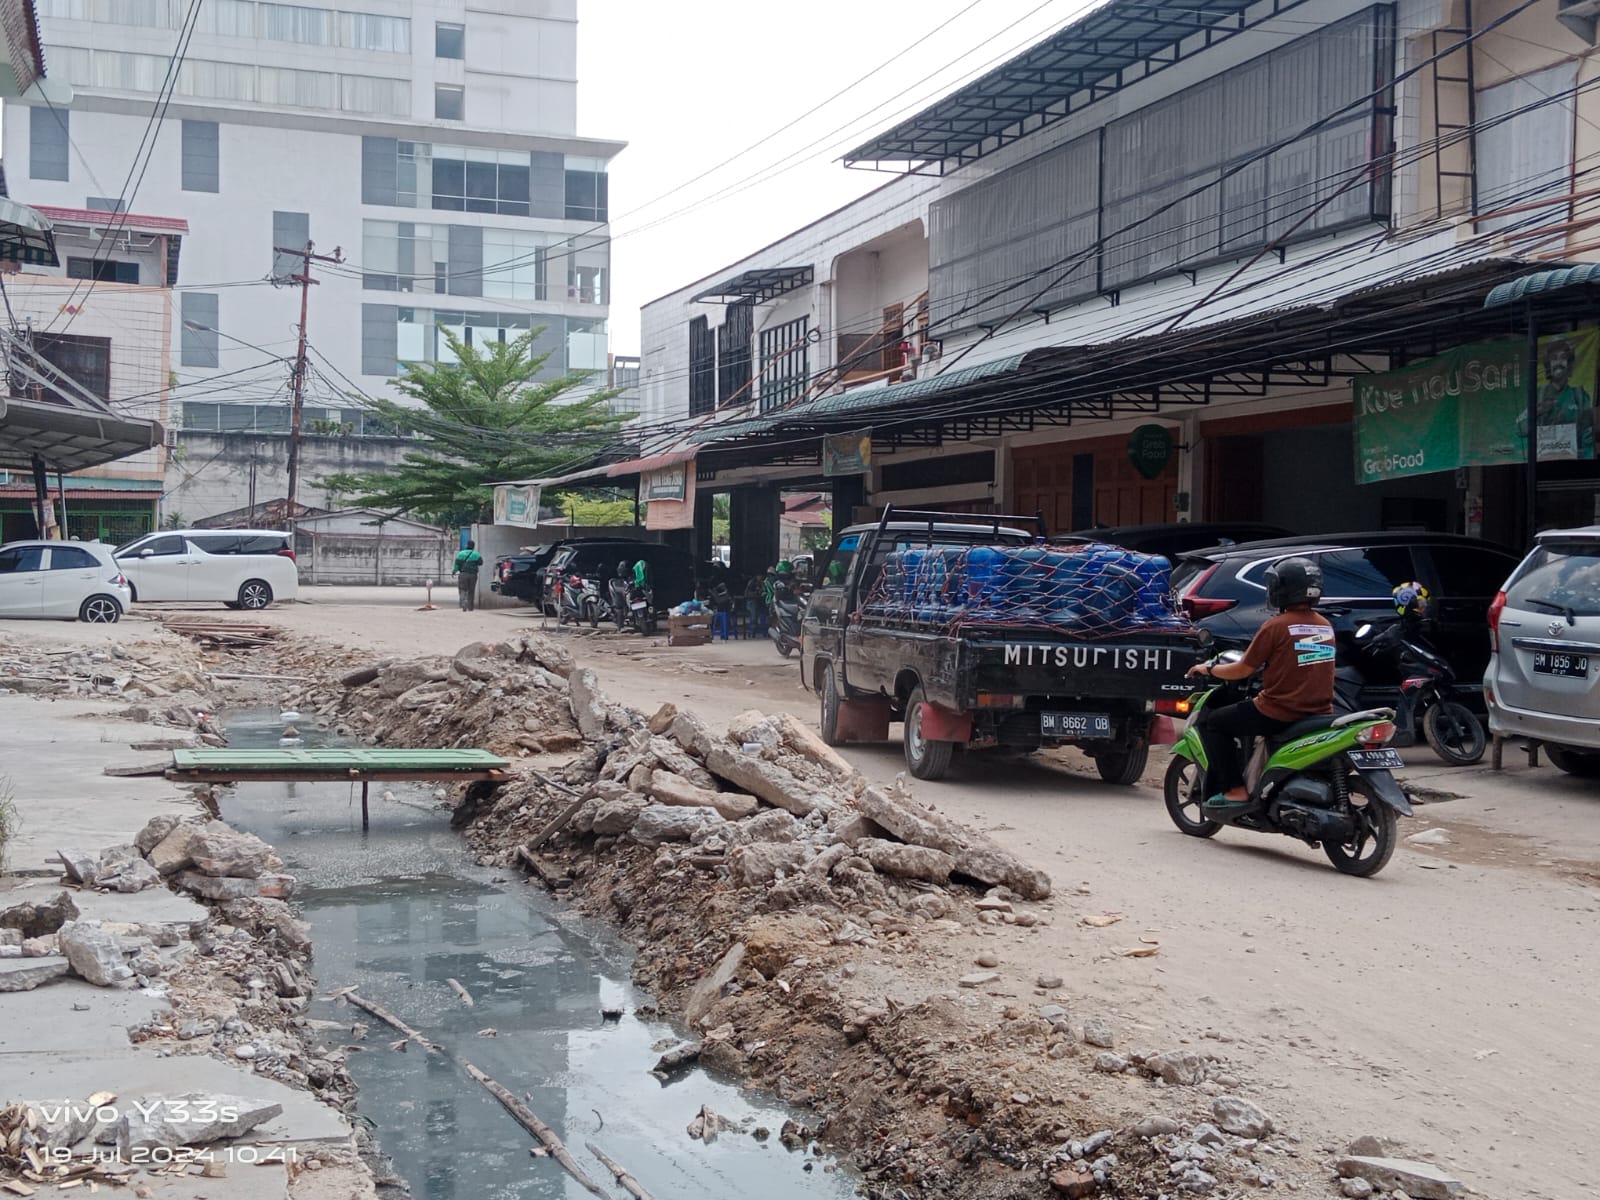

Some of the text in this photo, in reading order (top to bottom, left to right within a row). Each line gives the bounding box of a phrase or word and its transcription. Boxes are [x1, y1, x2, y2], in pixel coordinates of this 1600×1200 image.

[1360, 386, 1404, 416] Kue
[1463, 354, 1521, 392] Sari
[1142, 449, 1166, 459] Food
[1550, 655, 1570, 669] 1856
[1043, 715, 1055, 728] BM
[1062, 716, 1087, 729] 8662
